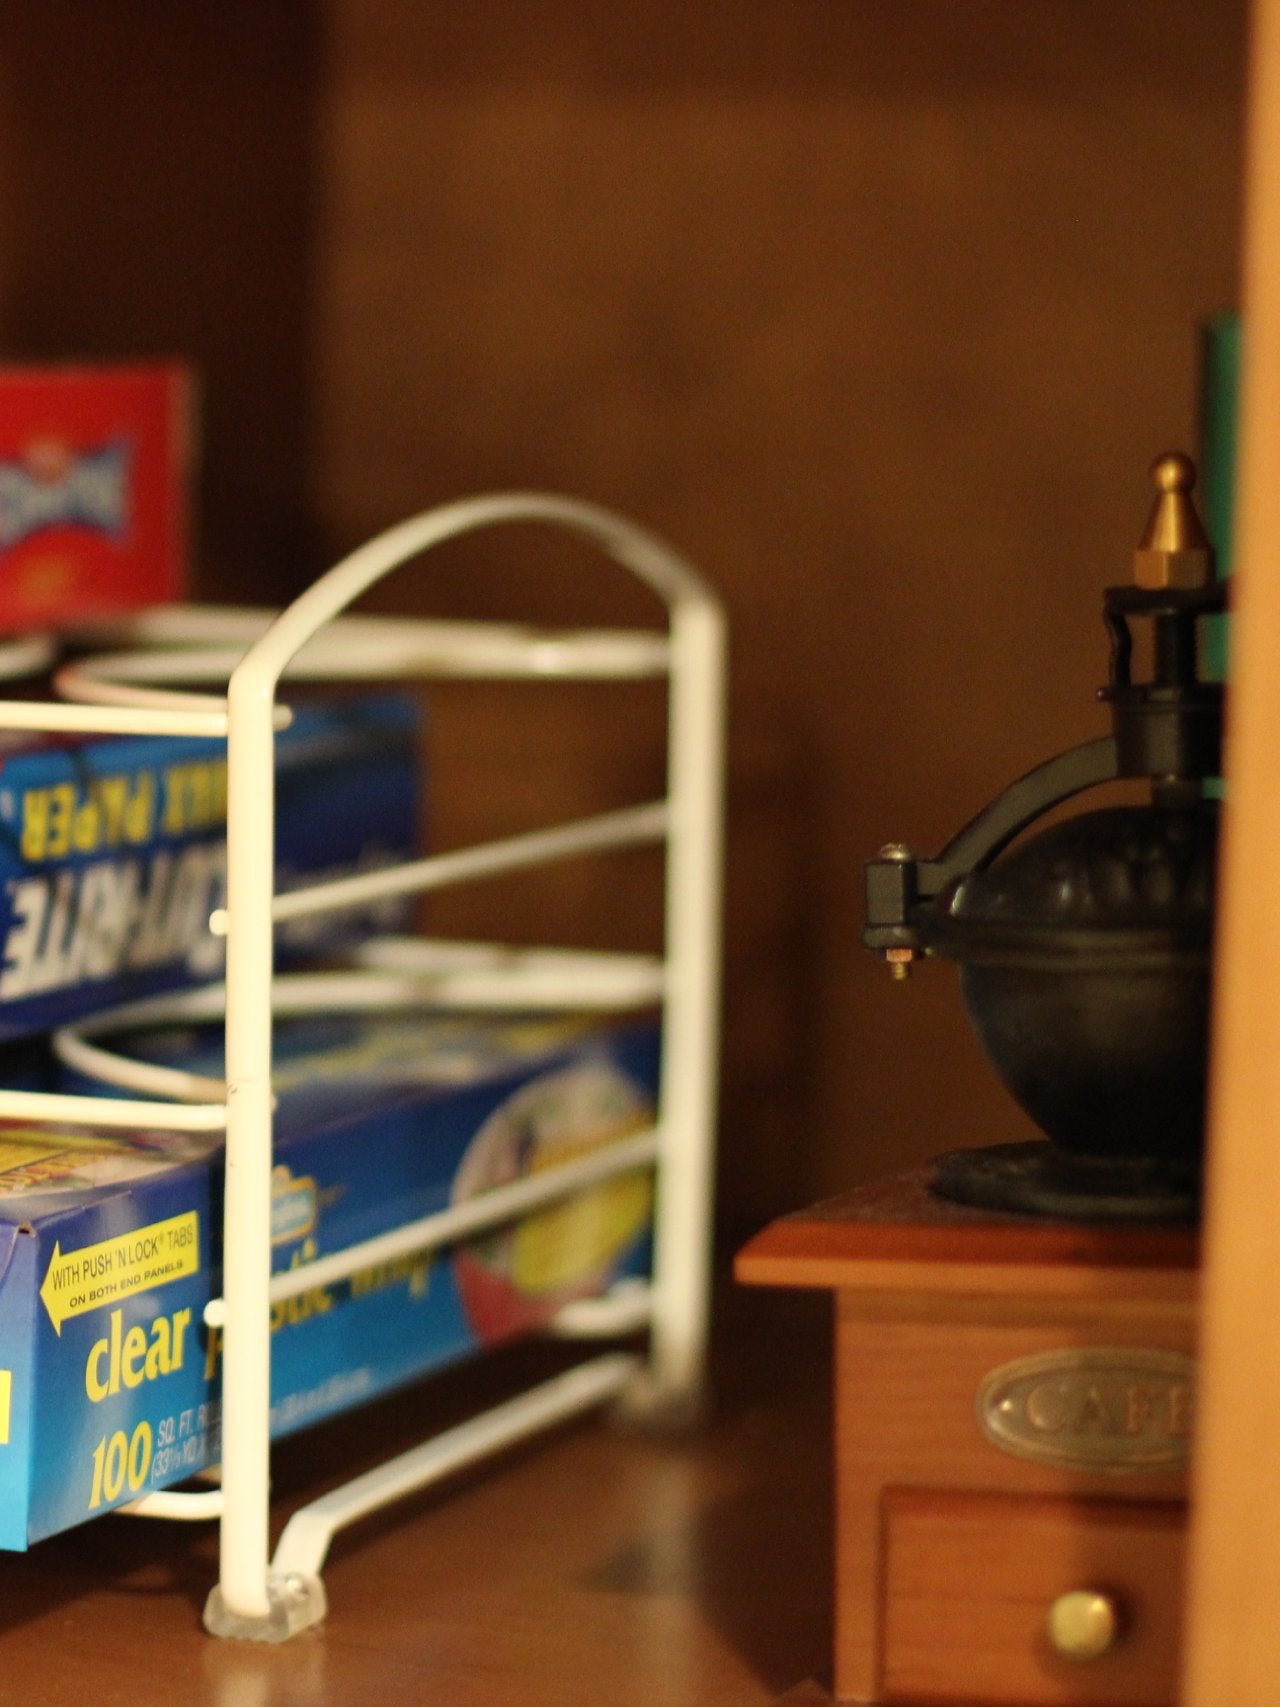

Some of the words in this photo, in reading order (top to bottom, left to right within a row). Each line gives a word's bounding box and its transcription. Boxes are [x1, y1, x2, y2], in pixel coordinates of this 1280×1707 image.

[51, 1263, 81, 1292] WITH
[82, 1253, 113, 1281] PUSH
[167, 1222, 194, 1250] TABS
[69, 1294, 86, 1309] ON
[88, 1283, 118, 1302] BOTH
[120, 1273, 141, 1290] END
[143, 1259, 184, 1284] PANELS
[85, 1307, 192, 1403] clear
[87, 1420, 154, 1510] 100
